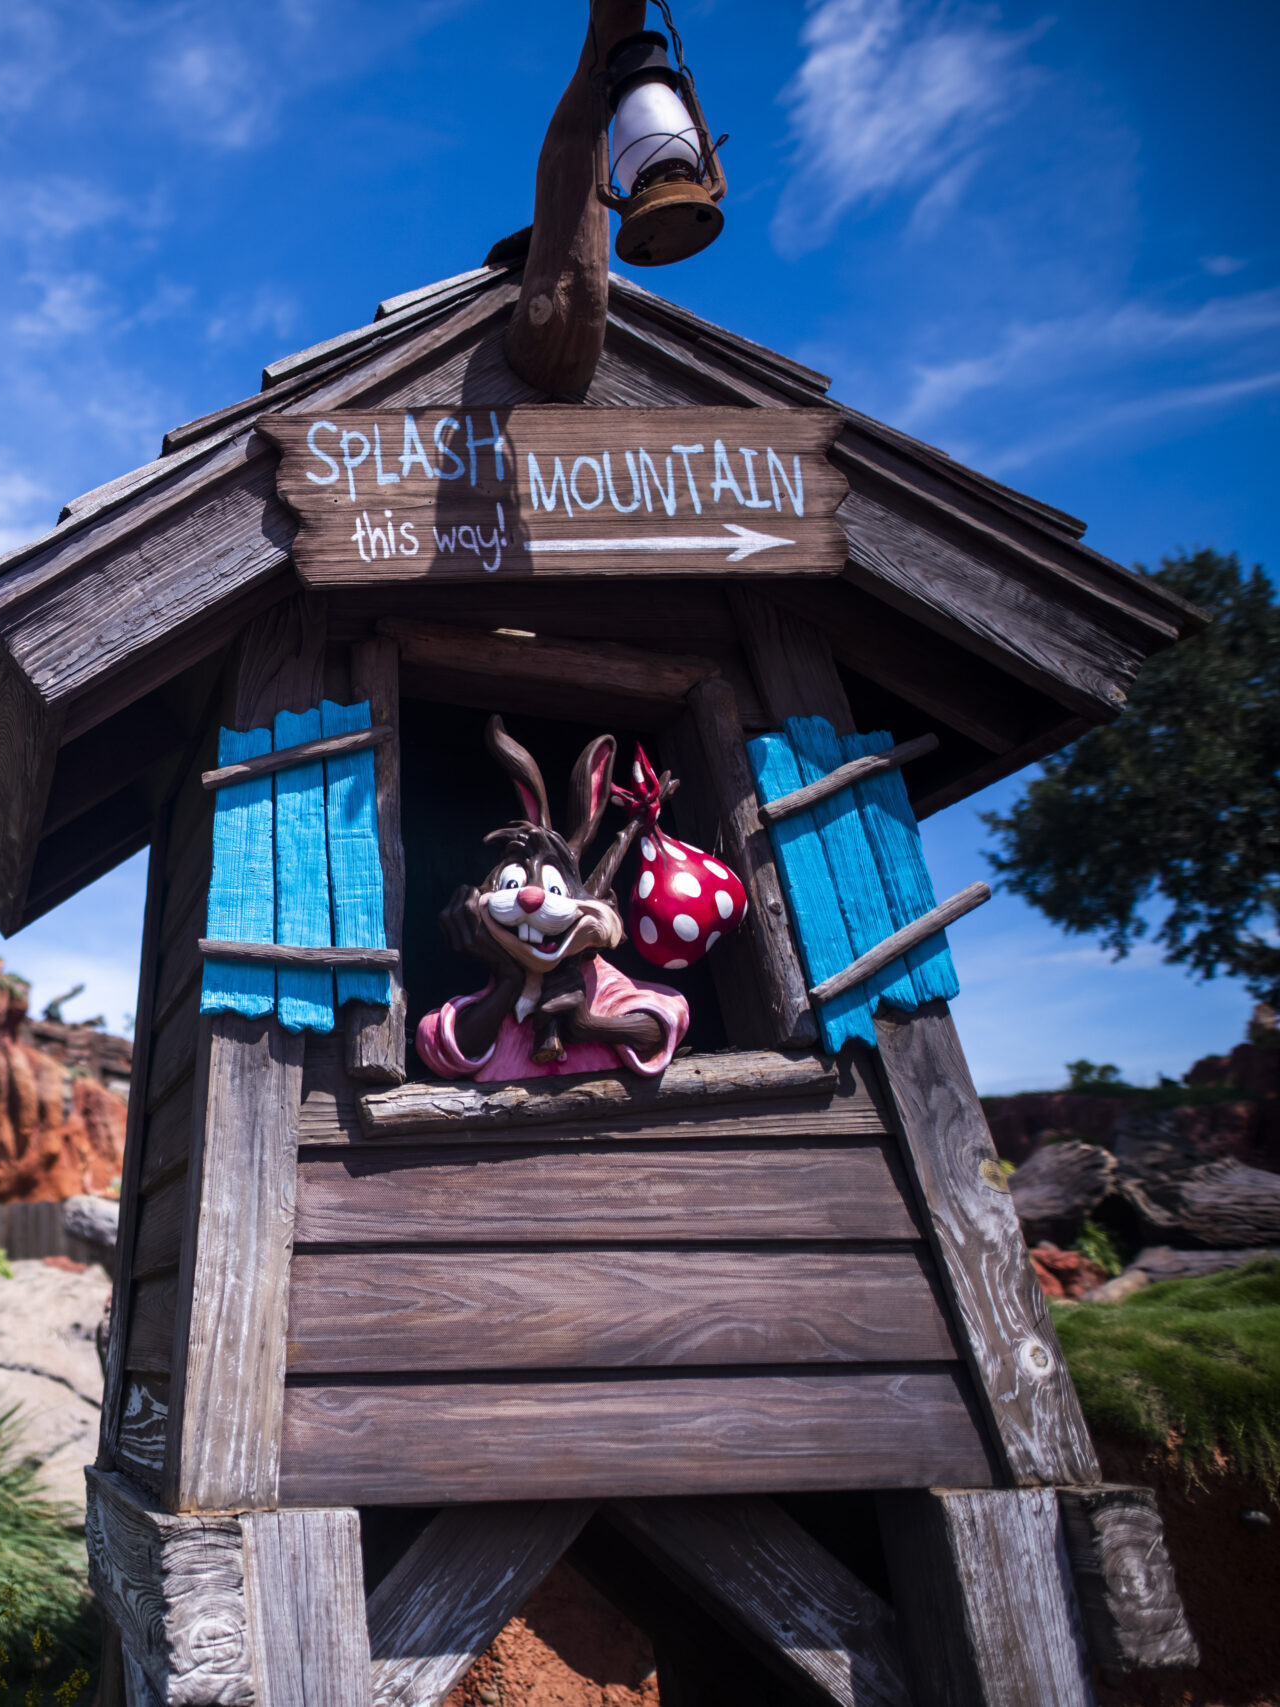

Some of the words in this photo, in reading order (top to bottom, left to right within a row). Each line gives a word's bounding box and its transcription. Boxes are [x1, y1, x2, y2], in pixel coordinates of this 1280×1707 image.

[305, 411, 506, 501] SPLASH
[527, 439, 805, 517] MOUNTAIN
[351, 510, 420, 563] this
[433, 503, 509, 573] way!
